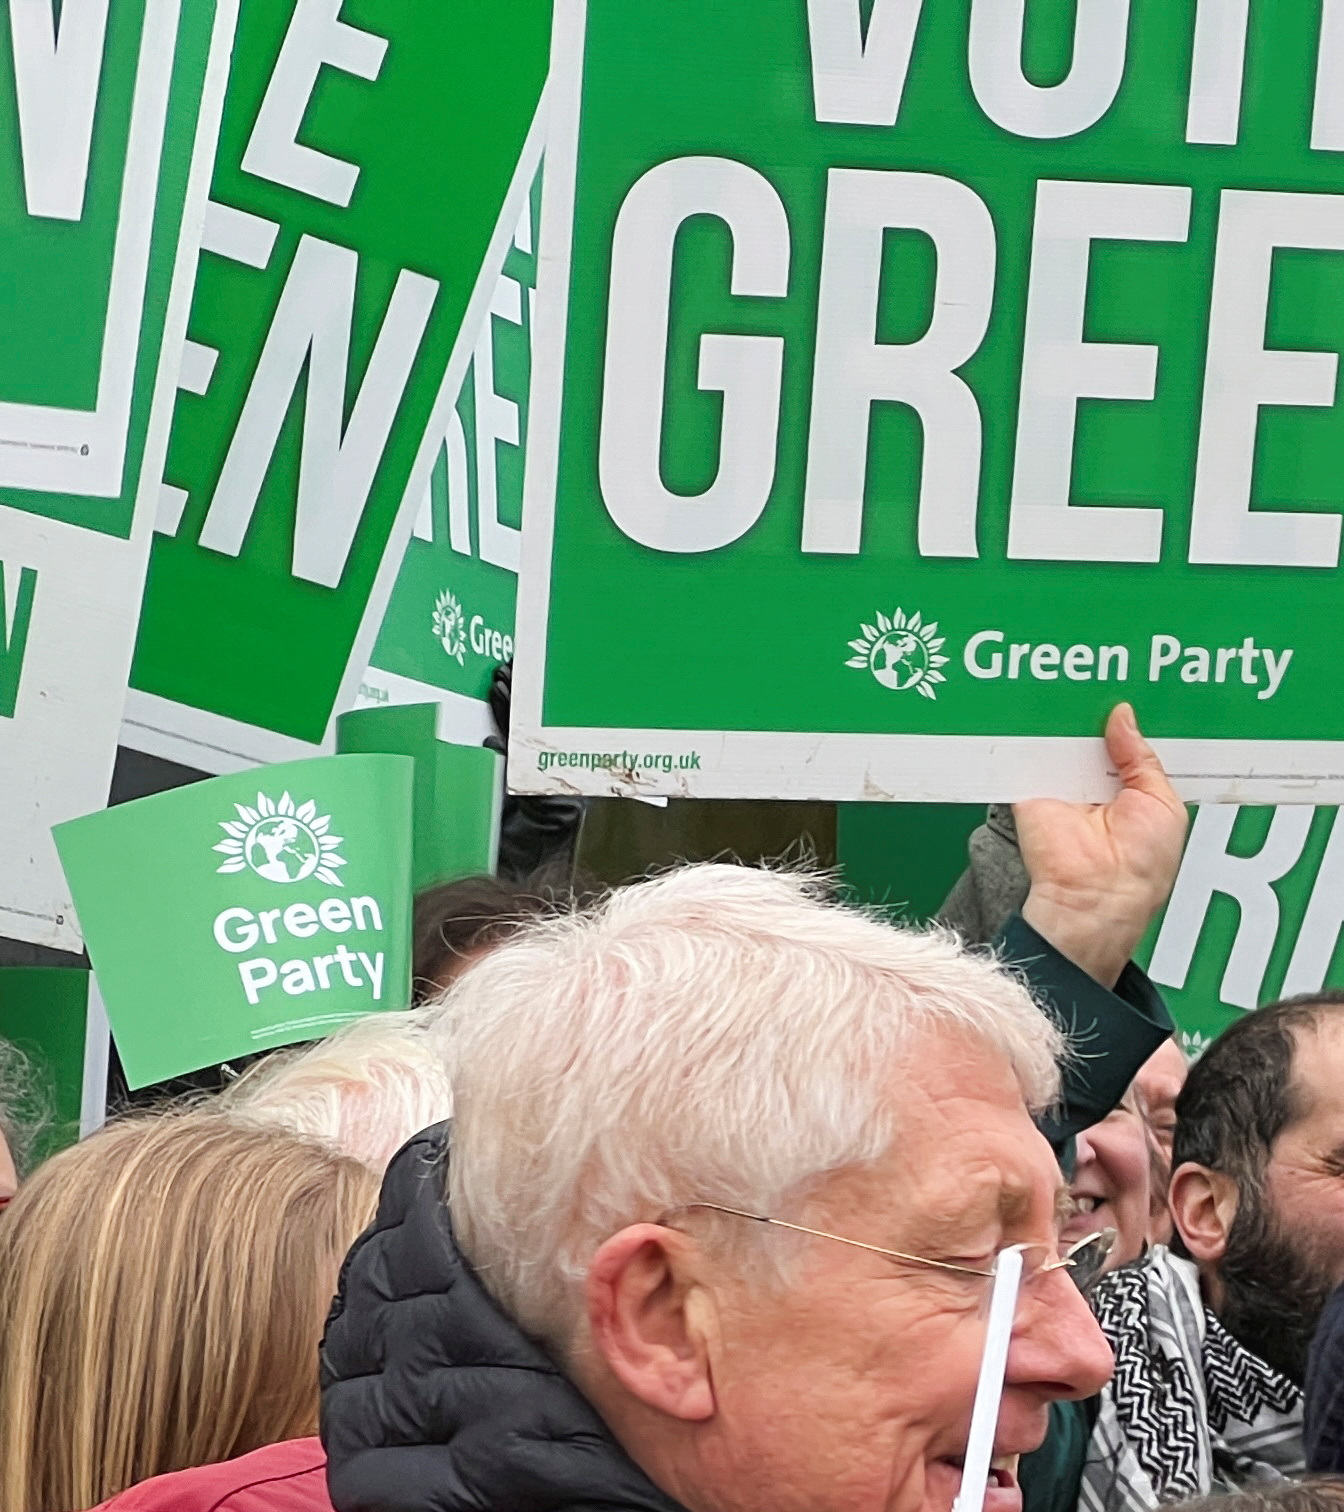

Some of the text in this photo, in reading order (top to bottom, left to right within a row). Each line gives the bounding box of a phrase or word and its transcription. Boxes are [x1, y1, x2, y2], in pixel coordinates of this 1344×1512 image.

[470, 615, 514, 663] Gree
[963, 630, 1295, 699] Green Party
[538, 749, 701, 773] greenparty.org.uk
[213, 895, 383, 953] Green
[238, 944, 384, 1005] Party
